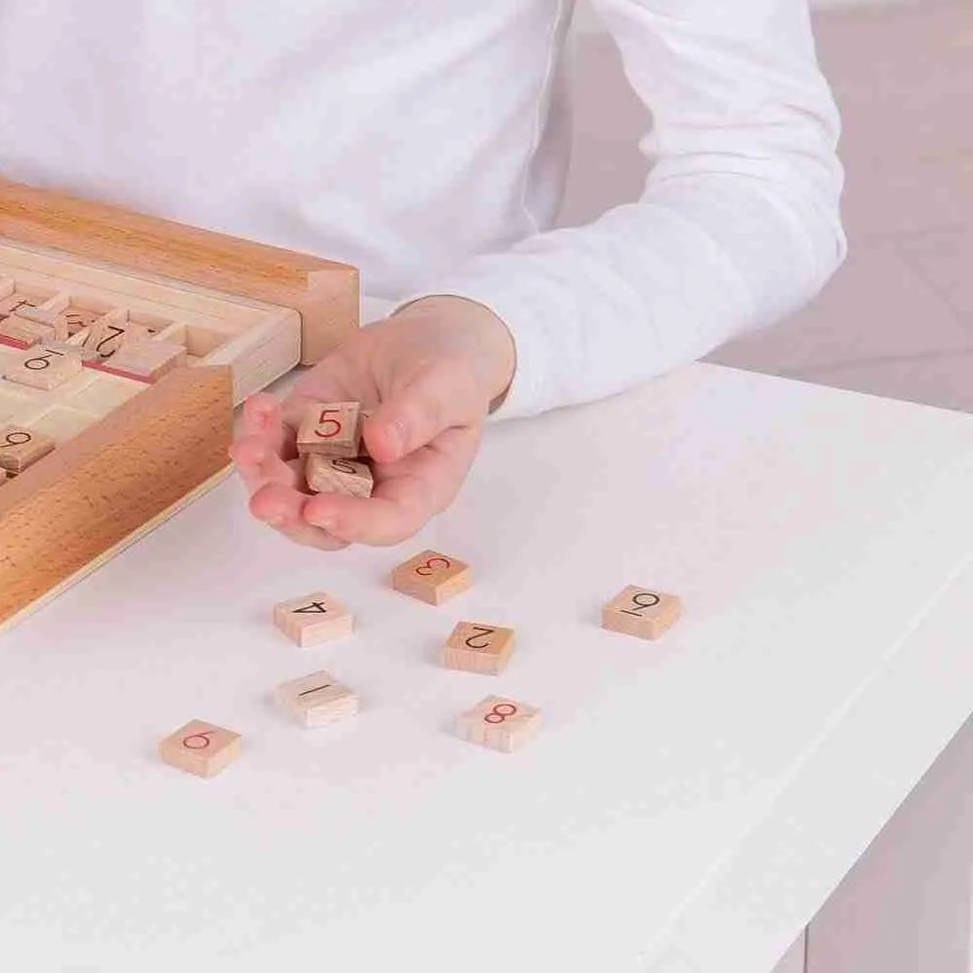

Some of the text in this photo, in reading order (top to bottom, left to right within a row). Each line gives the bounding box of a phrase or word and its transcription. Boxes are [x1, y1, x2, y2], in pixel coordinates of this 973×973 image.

[315, 410, 341, 437] 5
[416, 556, 451, 577] 3
[292, 600, 327, 615] 4
[466, 627, 494, 648] 2
[484, 704, 516, 723] 8
